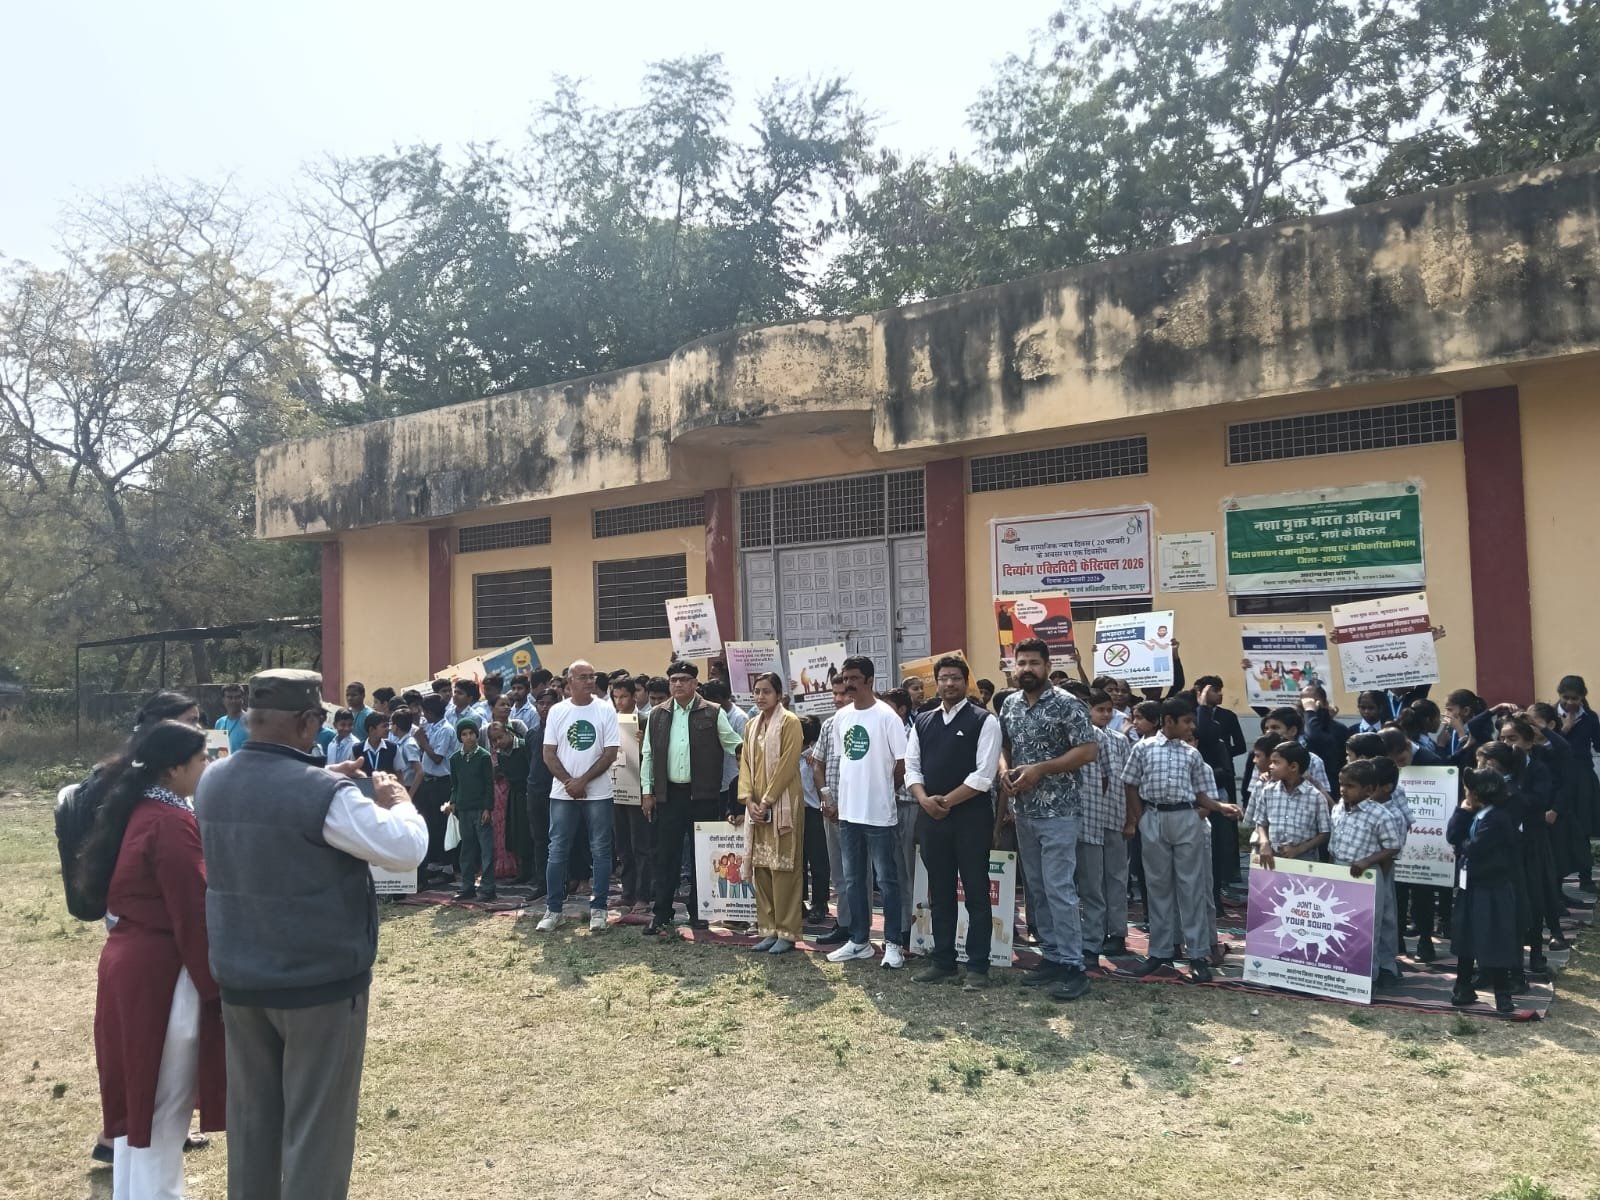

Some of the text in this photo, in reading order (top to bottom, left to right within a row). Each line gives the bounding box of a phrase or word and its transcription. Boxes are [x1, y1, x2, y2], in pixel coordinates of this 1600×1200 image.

[1254, 510, 1401, 532] नशा मुक्त भारत अभियान
[1276, 532, 1294, 543] एक
[1321, 528, 1340, 539] नशे
[1342, 526, 1353, 537] के
[1014, 544, 1029, 553] विश्व
[1030, 541, 1057, 551] सामाजिक
[1058, 541, 1073, 550] न्याय
[1074, 539, 1091, 548] दिवस
[1097, 538, 1105, 546] 20
[1106, 536, 1125, 546] फरवरी
[1392, 538, 1416, 548] विभाग
[1036, 550, 1043, 559] के
[1044, 550, 1062, 558] अवसर
[1064, 550, 1071, 558] पर
[1072, 549, 1083, 558] एक
[1003, 558, 1144, 577] दिव्यांग एक्टिविटी फेस्टिवल 2026
[1376, 651, 1408, 662] 14446
[1408, 826, 1443, 836] 14446
[1291, 908, 1310, 918] DRUGS
[1286, 916, 1332, 931] YOUR SQUAD
